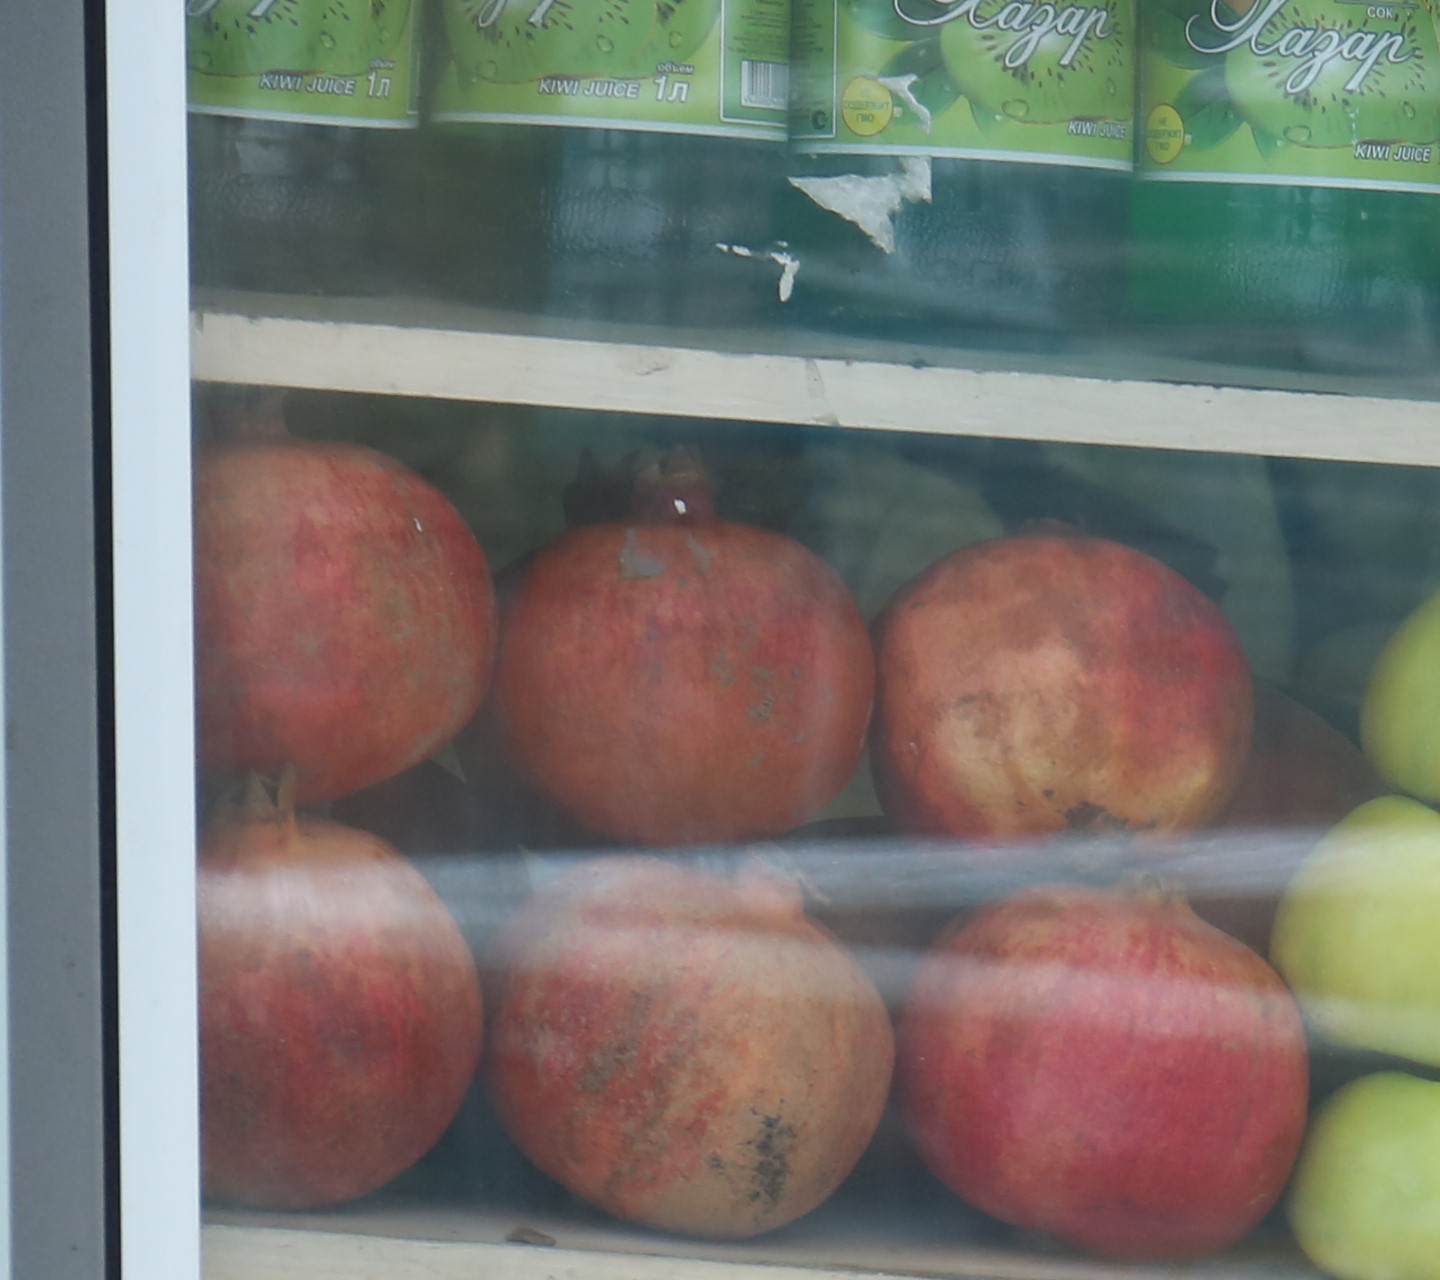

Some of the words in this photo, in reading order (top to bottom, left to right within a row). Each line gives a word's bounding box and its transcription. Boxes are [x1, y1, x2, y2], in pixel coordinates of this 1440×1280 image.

[259, 73, 301, 92] KIWI
[305, 75, 356, 96] JUICE
[538, 77, 579, 96] KIWI
[583, 80, 640, 99] JUICE
[653, 74, 690, 102] 1л
[1353, 143, 1391, 161] KIWI
[1392, 146, 1431, 163] JUICE
